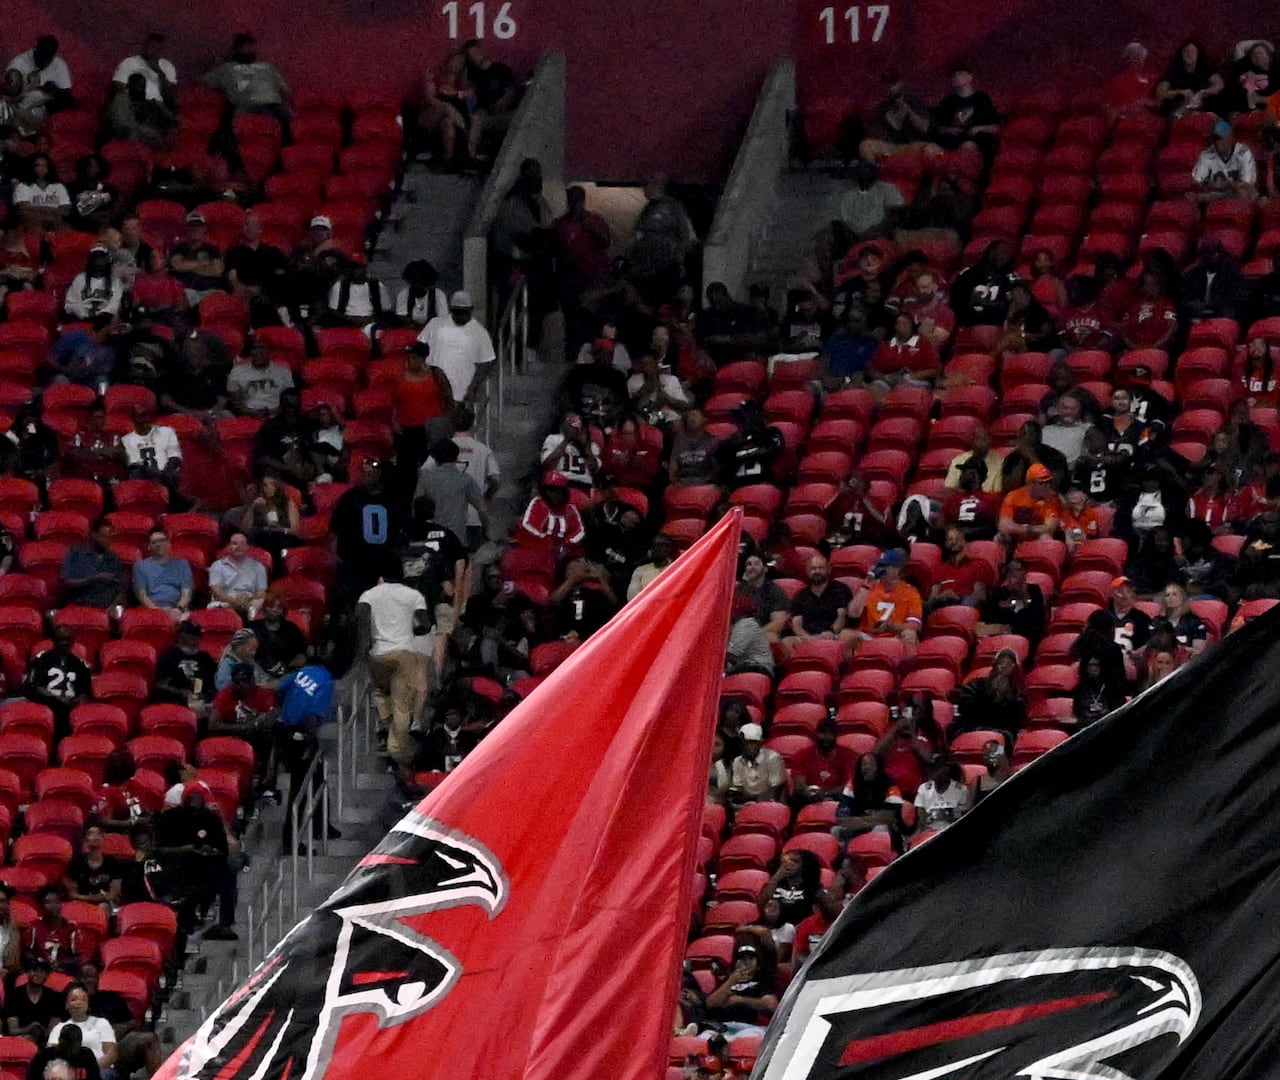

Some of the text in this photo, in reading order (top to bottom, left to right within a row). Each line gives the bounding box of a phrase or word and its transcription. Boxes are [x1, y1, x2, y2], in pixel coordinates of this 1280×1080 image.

[442, 1, 517, 40] 116
[819, 4, 891, 44] 117
[362, 503, 389, 546] 0
[876, 602, 896, 621] 7
